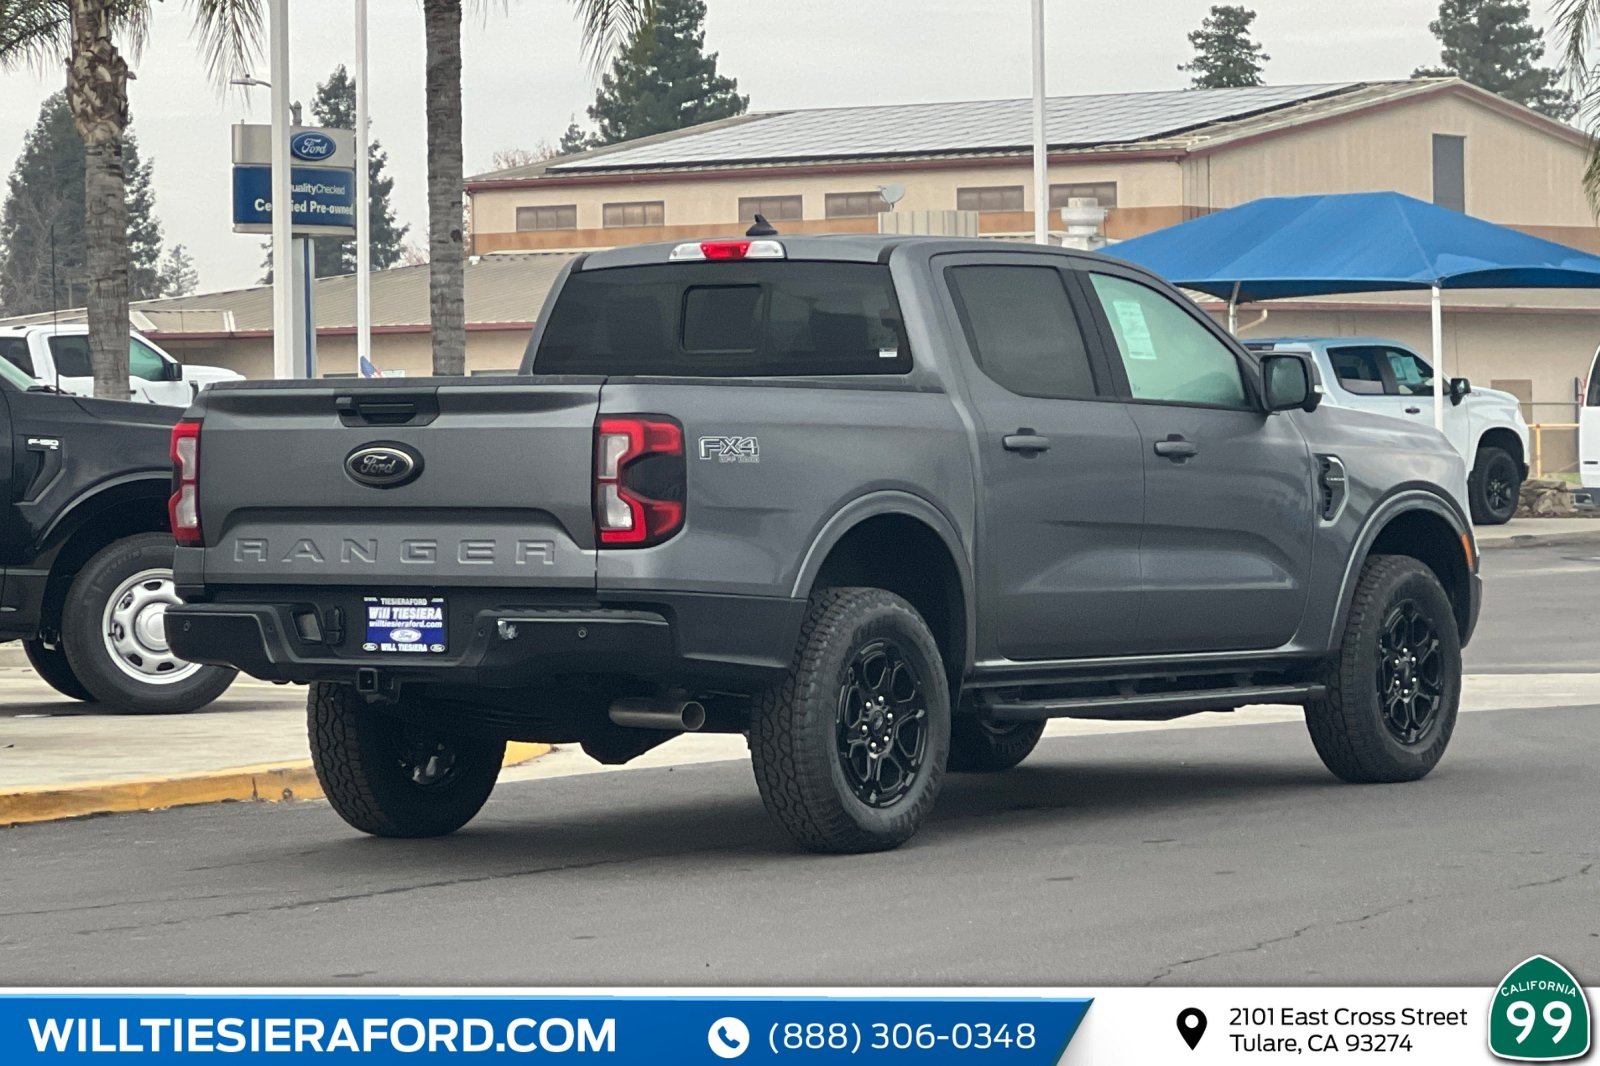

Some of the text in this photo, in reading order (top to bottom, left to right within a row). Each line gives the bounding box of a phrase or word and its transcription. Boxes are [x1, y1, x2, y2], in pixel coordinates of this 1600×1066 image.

[301, 138, 327, 154] Ford
[290, 183, 345, 196] ualityChecked
[254, 198, 354, 215] Ceied Pre-owned
[698, 436, 760, 460] FX4
[361, 454, 396, 473] Ford
[233, 538, 555, 565] RANGER
[392, 607, 442, 620] TIESIERA
